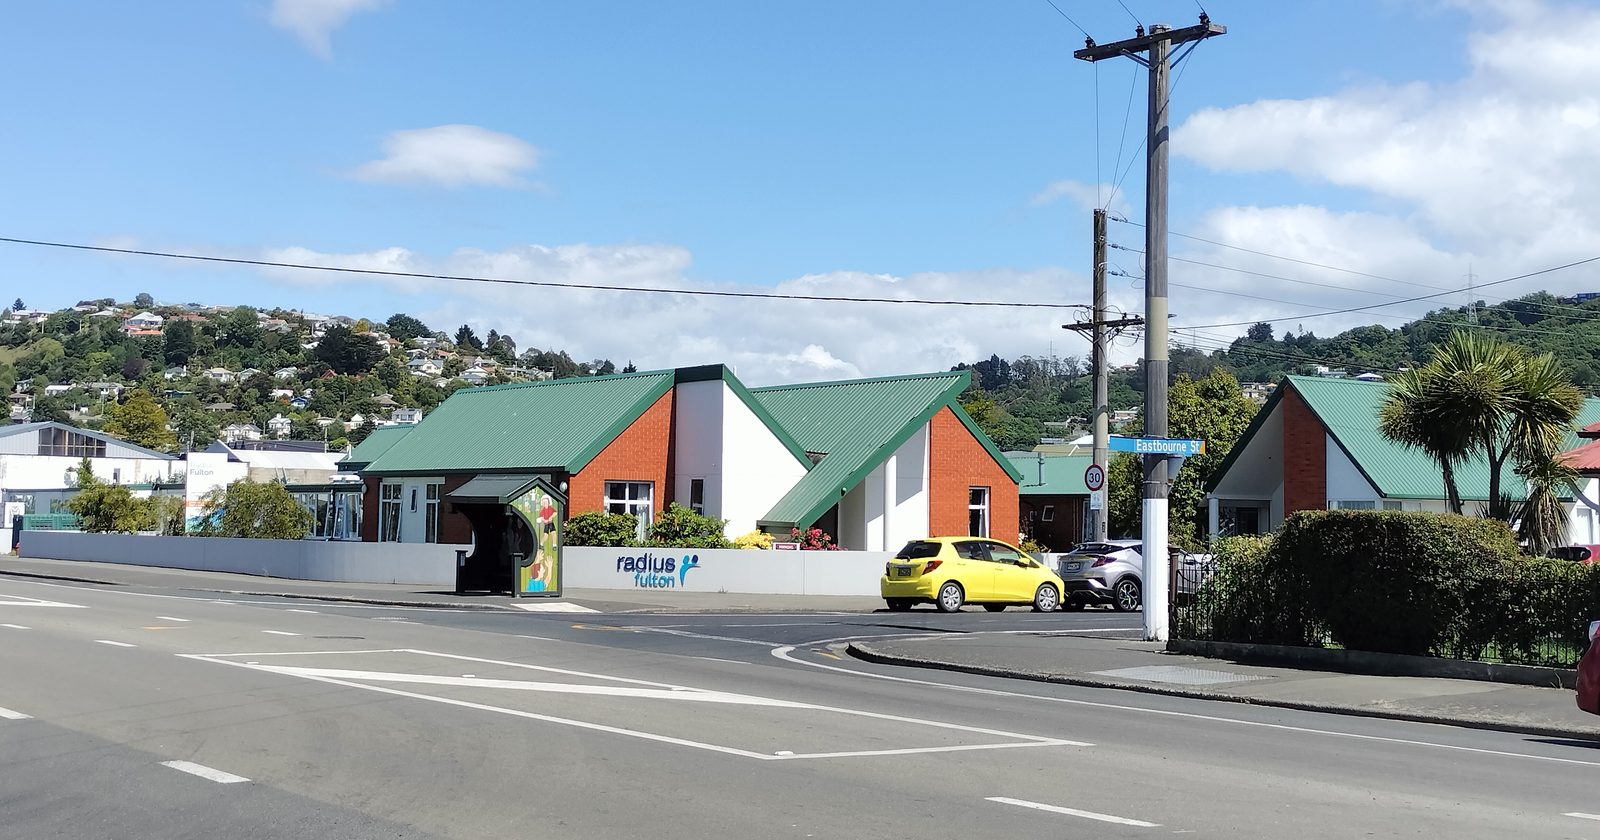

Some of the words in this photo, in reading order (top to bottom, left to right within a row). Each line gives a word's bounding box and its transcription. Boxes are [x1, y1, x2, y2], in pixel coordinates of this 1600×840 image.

[1136, 439, 1187, 453] Eastbourne
[1190, 441, 1200, 453] St
[1089, 473, 1100, 483] 30
[616, 552, 676, 573] radius
[634, 573, 675, 588] fulton
